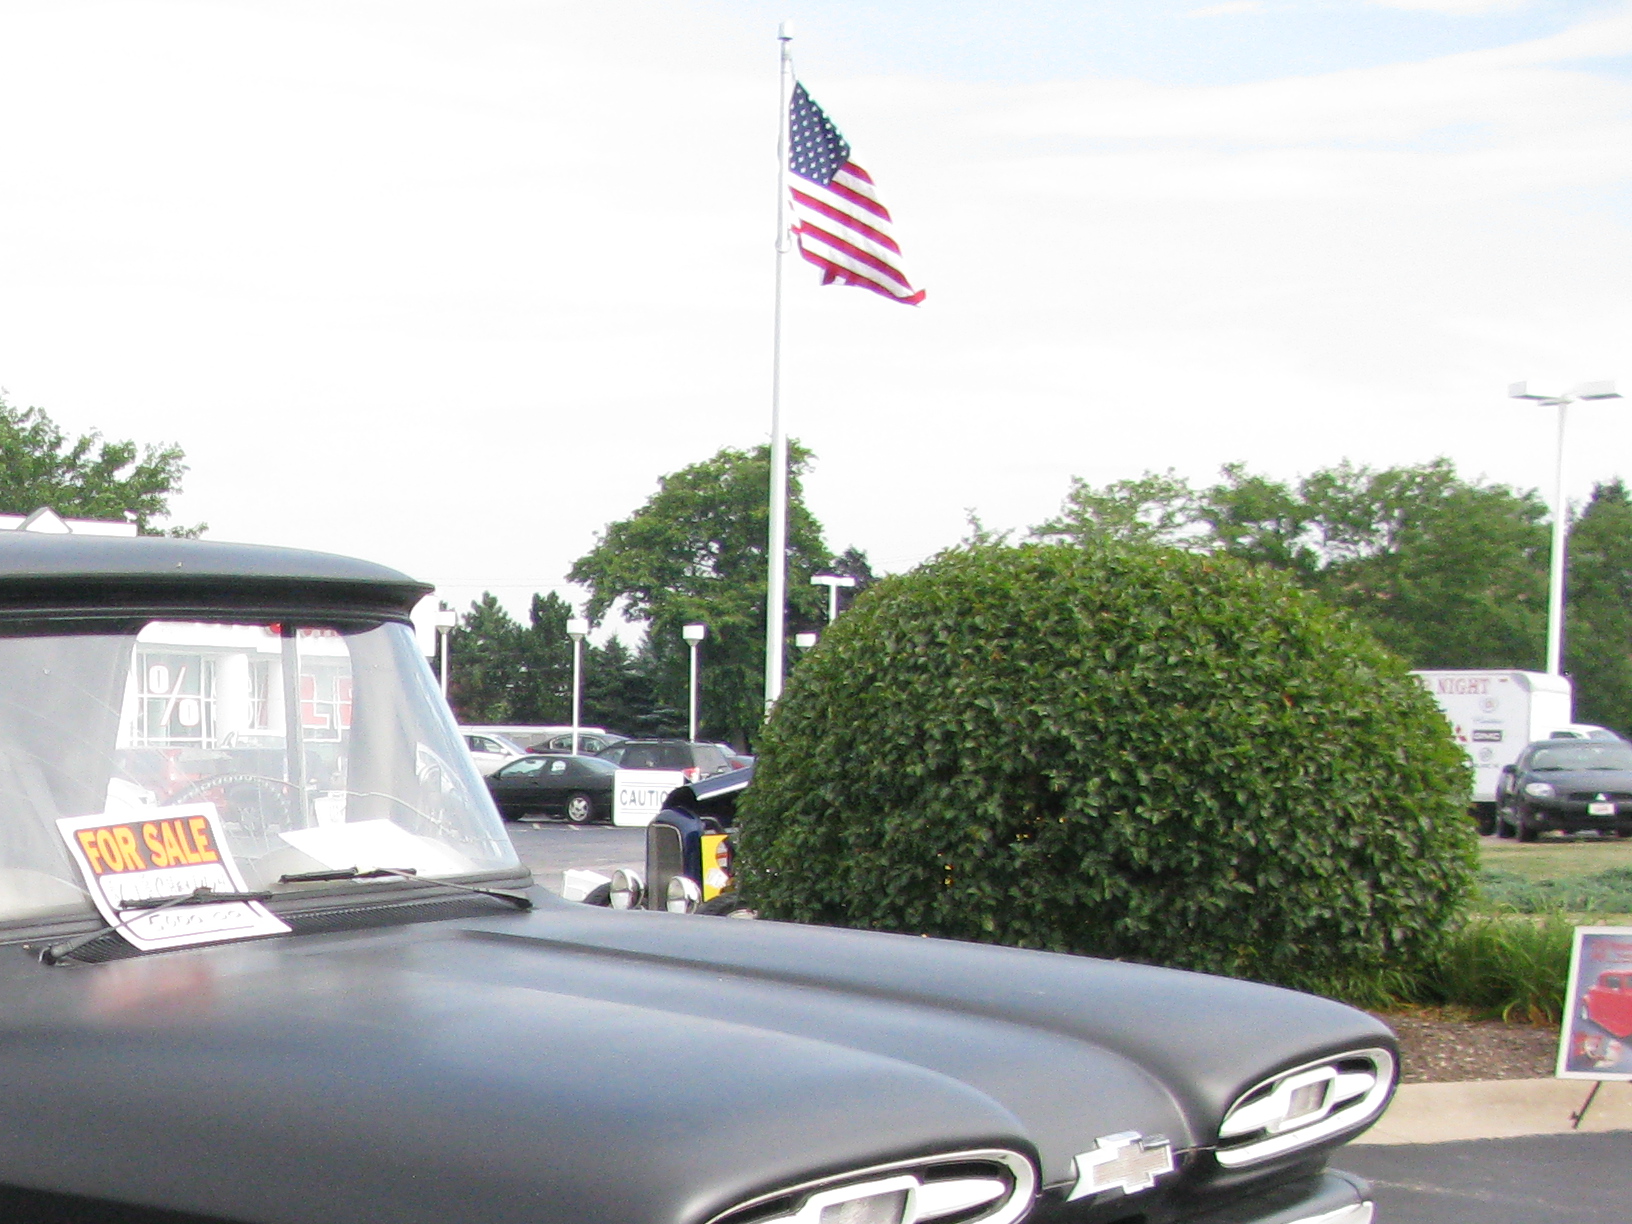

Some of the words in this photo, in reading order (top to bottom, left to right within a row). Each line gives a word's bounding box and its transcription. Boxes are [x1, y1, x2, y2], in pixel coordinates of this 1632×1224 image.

[1437, 678, 1490, 694] NIGHT
[76, 825, 148, 875] FOR
[142, 815, 218, 868] SALE
